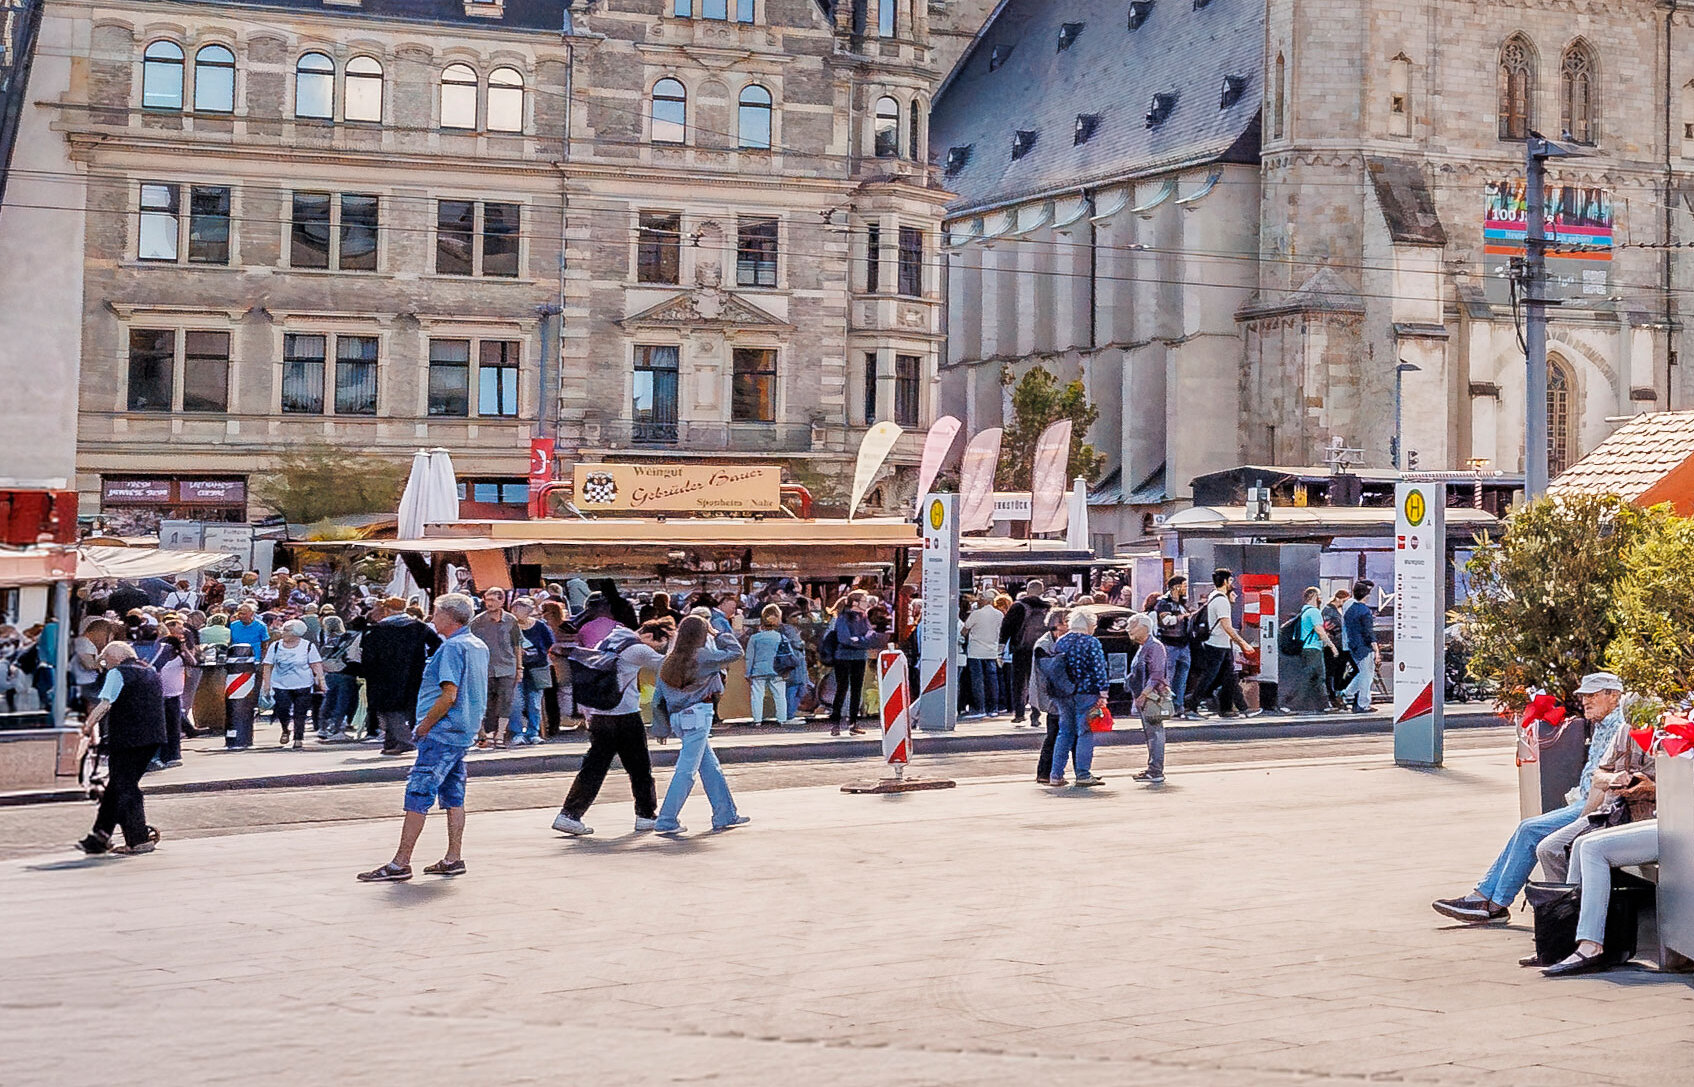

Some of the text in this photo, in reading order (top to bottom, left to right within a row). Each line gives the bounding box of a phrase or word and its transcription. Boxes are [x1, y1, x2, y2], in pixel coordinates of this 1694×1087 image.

[1492, 209, 1516, 221] 100
[633, 466, 683, 478] Weingut
[630, 469, 763, 508] Gebrüder Bauer
